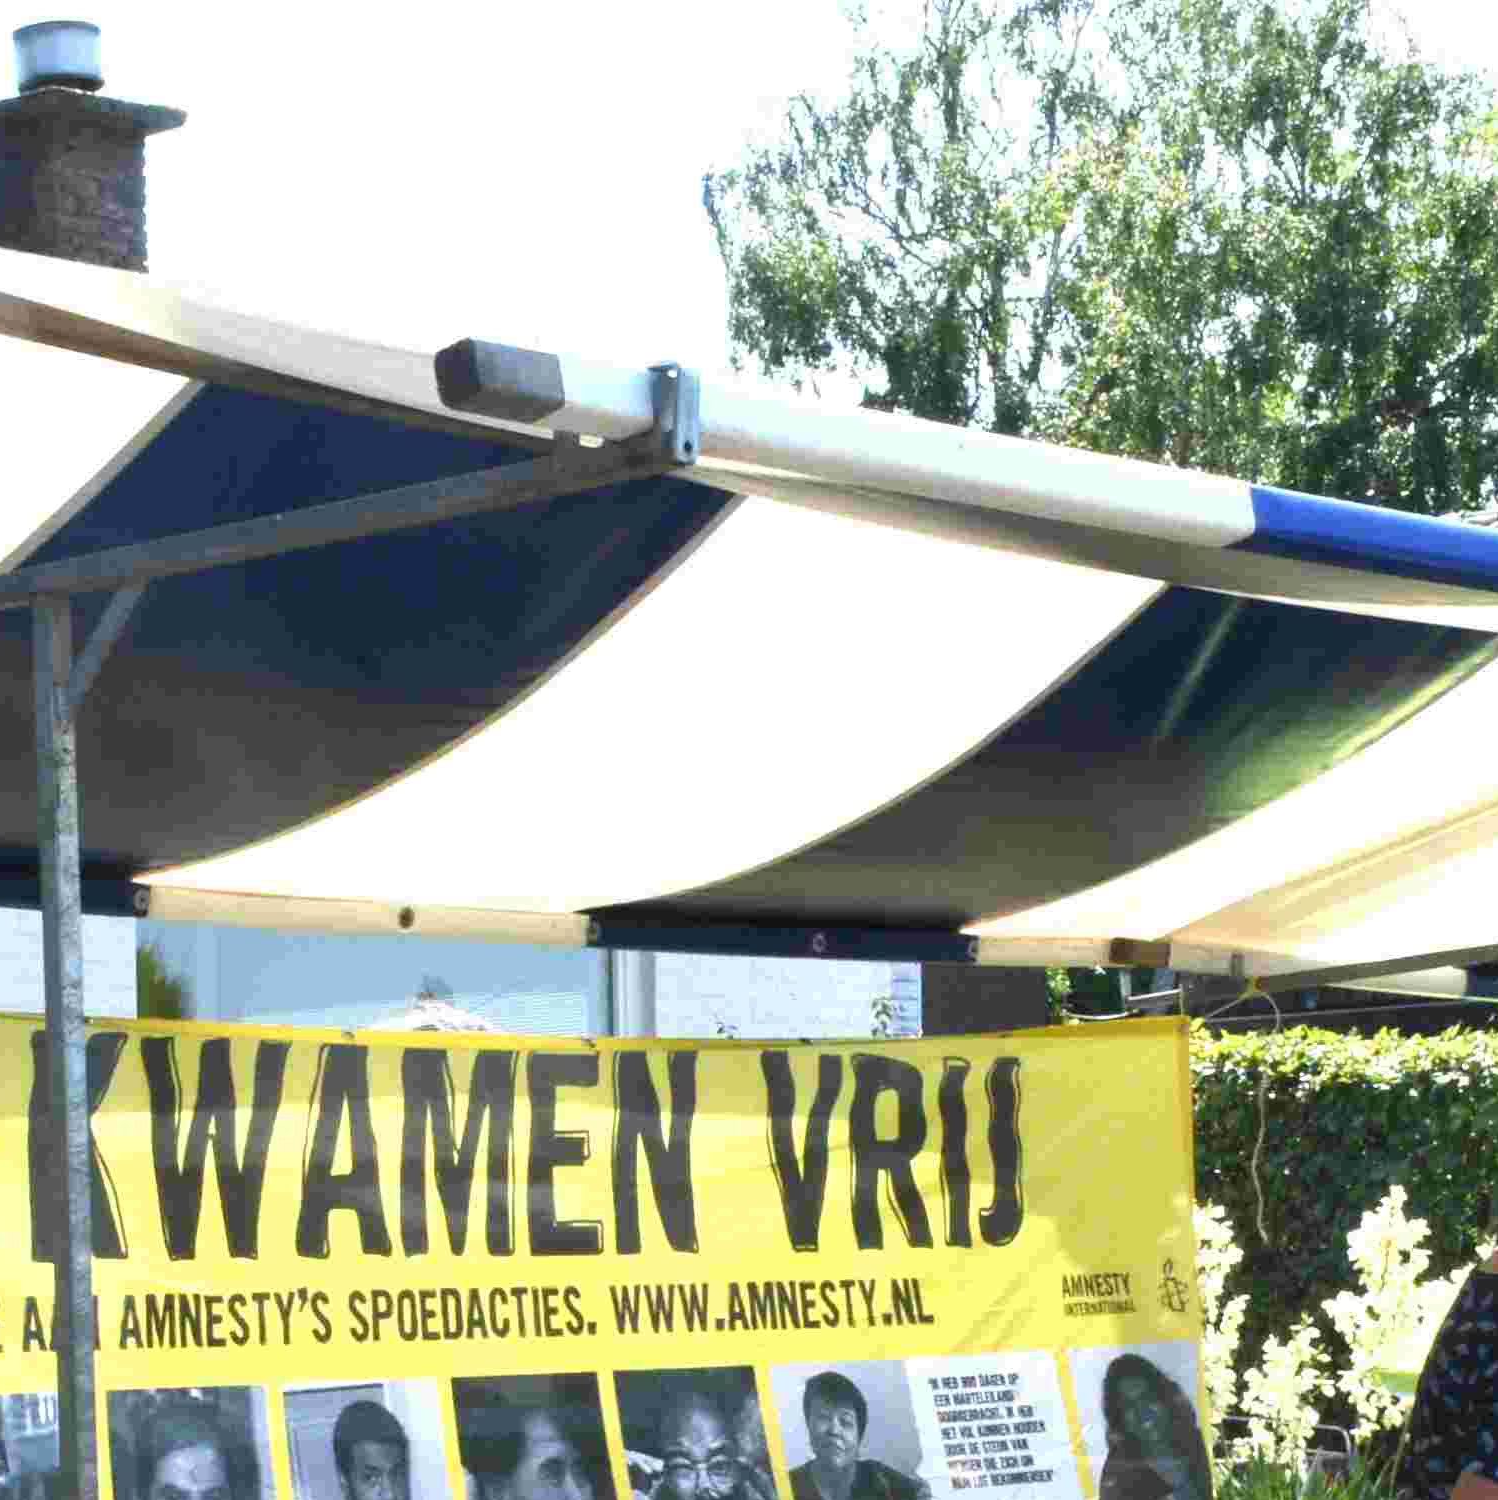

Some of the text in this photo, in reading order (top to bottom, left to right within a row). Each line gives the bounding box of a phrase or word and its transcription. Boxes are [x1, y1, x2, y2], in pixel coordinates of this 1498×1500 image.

[28, 1028, 700, 1265] KWAMEN
[759, 1049, 1025, 1254] VRIJ
[118, 1286, 333, 1349] AMNESTY'S
[348, 1284, 599, 1345] SPOEDACTIES.
[611, 1277, 935, 1336] WWW.AMNESTY.NL
[1061, 1271, 1131, 1298] AMNESTY
